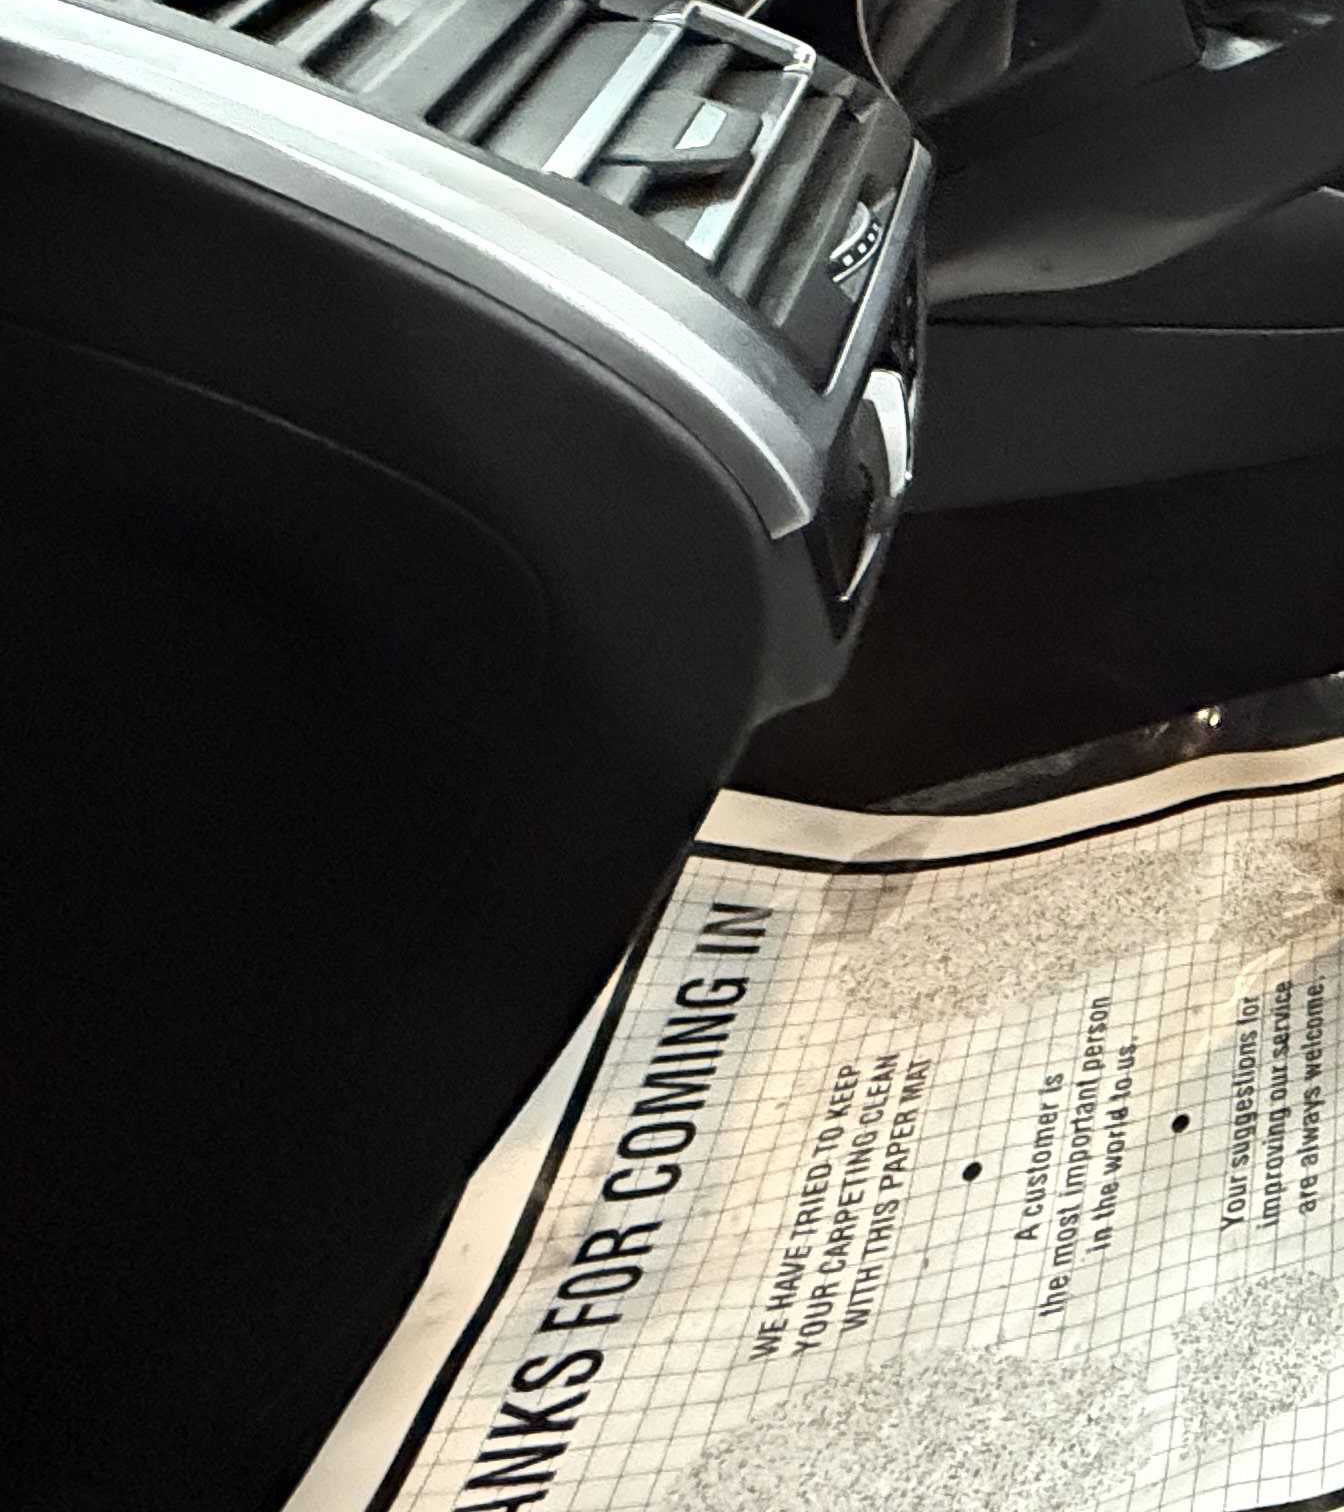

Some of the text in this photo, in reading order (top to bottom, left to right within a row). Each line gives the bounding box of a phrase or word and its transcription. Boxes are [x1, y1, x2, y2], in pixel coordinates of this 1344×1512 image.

[535, 1220, 663, 1334] FOR
[601, 977, 750, 1202] COMING
[695, 902, 773, 954] IN
[749, 1064, 861, 1361] WE HAVE TRIED TO KEEP
[792, 1051, 900, 1357] YOUR CARPETING CLEAN
[840, 1058, 932, 1333] WITH THIS PAPER MAT
[1014, 1073, 1064, 1240] A customer is
[1039, 996, 1111, 1316] the most important person
[1086, 1036, 1138, 1254] in the world to us.
[1220, 996, 1260, 1232] Your suggestions for
[1256, 980, 1293, 1229] improving our service
[1297, 975, 1326, 1215] are always welcome.
